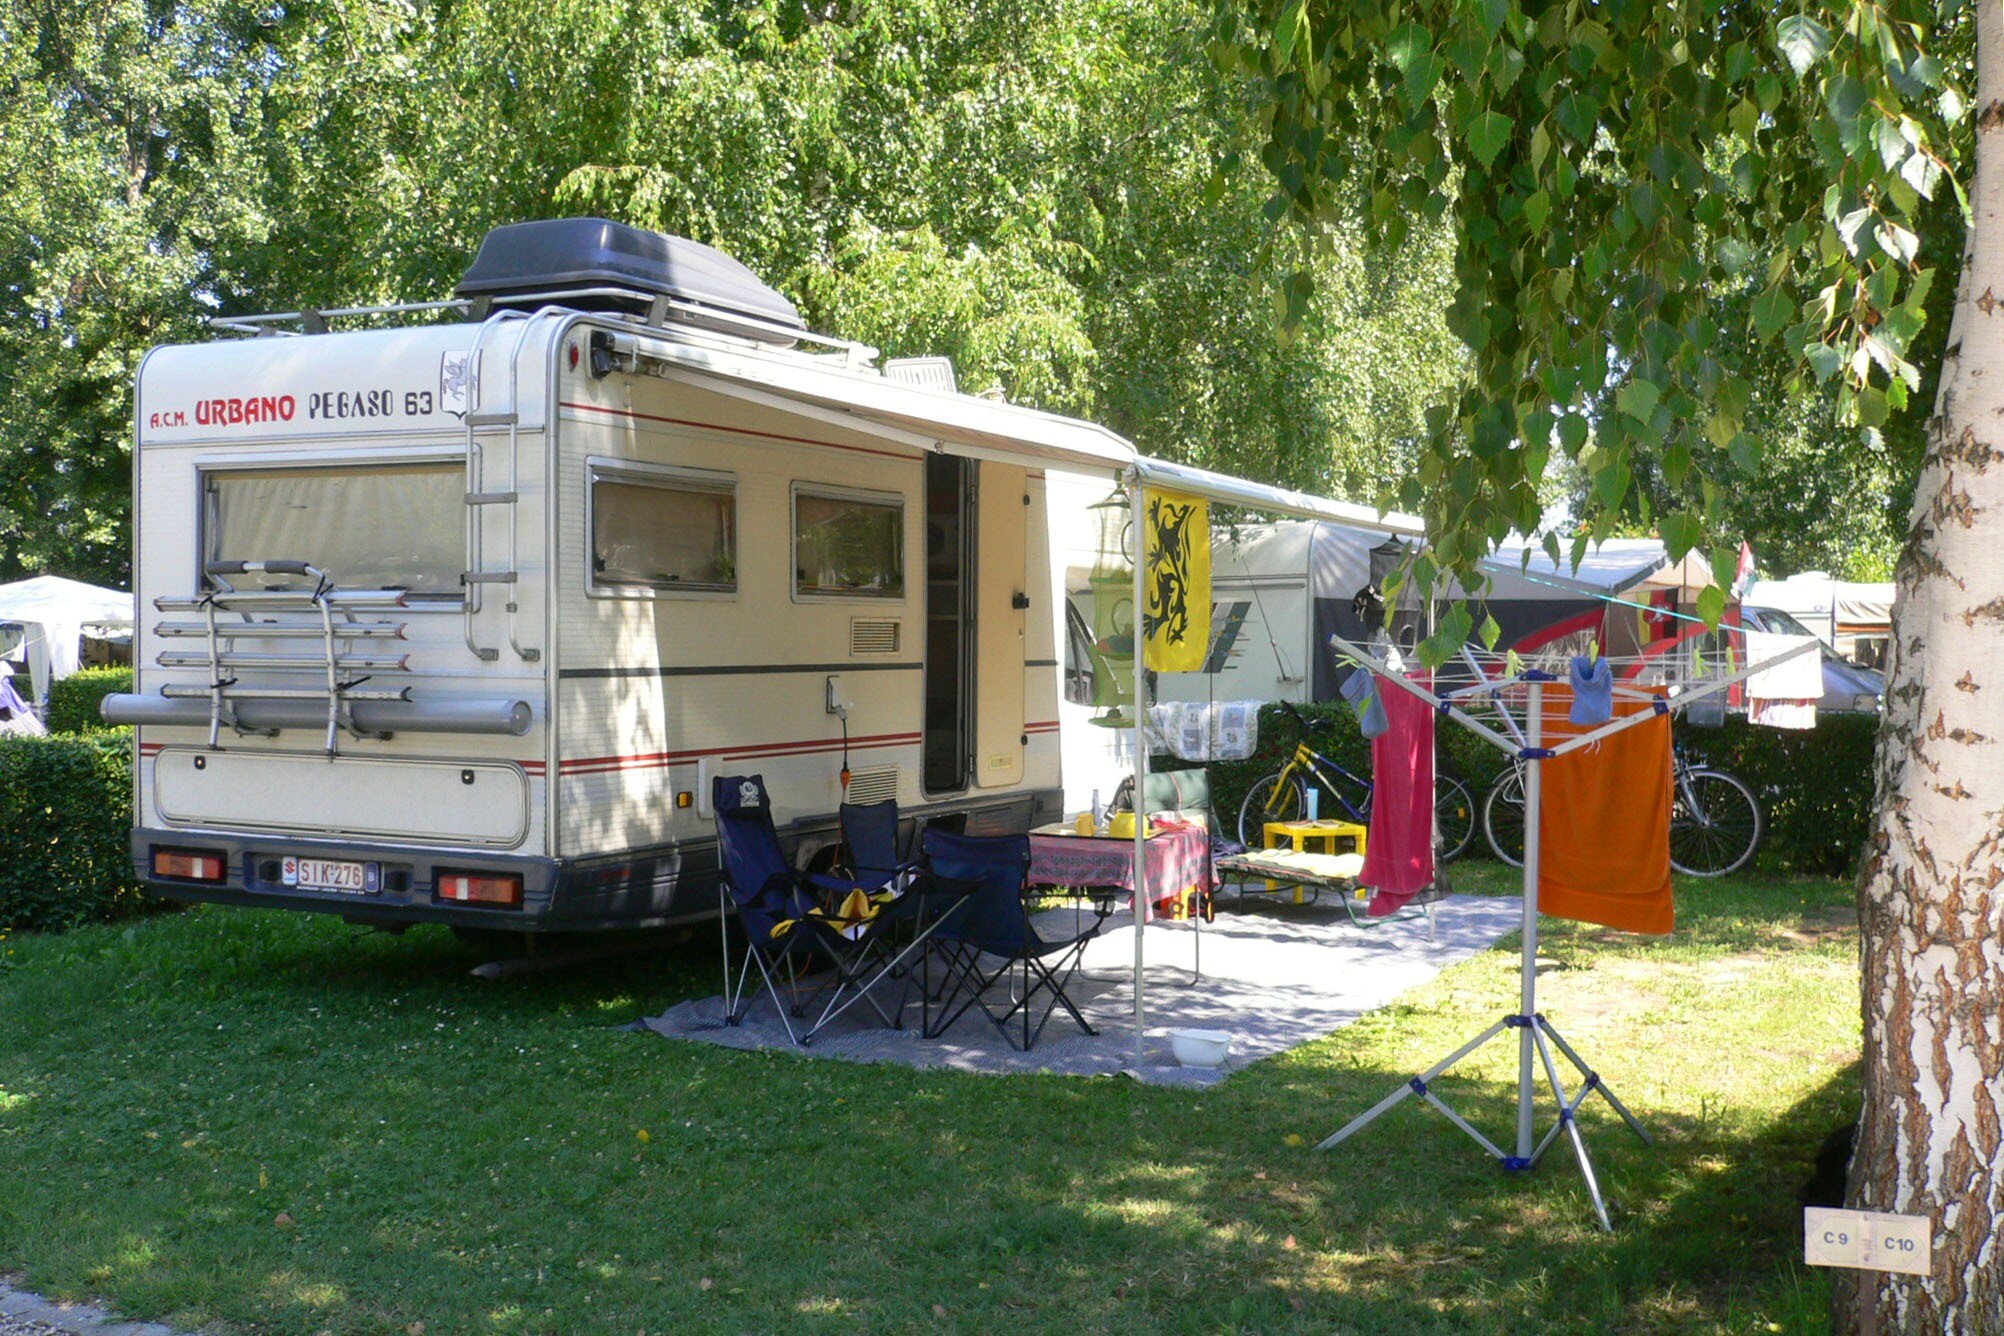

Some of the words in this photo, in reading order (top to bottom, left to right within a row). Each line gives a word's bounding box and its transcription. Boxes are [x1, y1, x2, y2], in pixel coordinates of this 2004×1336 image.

[150, 411, 189, 429] A.C.M.
[195, 396, 295, 427] URBANO
[309, 390, 394, 420] PEGASO
[405, 391, 433, 416] 63
[1884, 1237, 1914, 1251] C10
